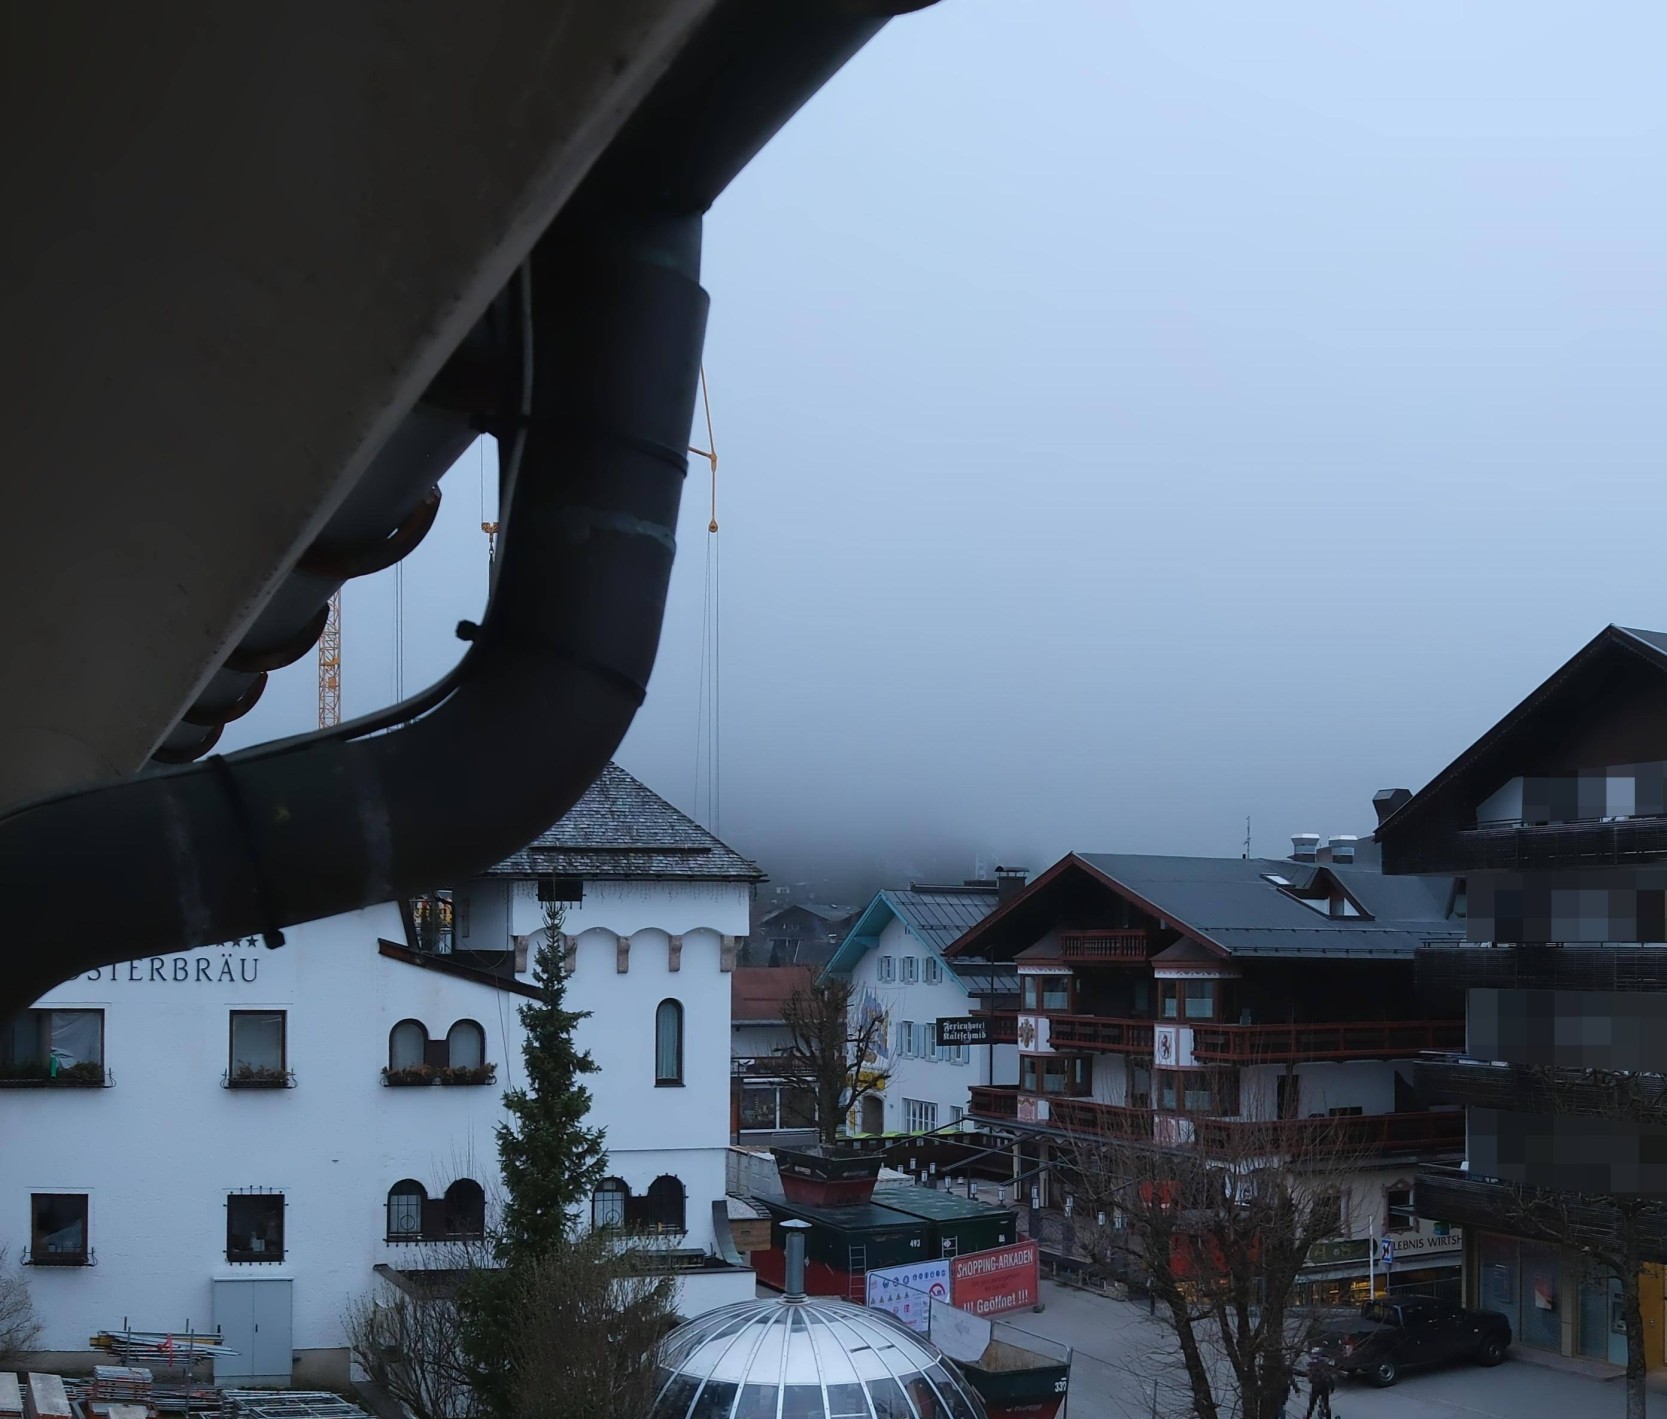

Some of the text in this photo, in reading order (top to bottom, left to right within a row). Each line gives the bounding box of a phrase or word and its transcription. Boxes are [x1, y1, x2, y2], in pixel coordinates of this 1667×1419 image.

[70, 953, 259, 982] STERBRÄU
[957, 1249, 1033, 1278] SHOPPING-ARKADEN
[976, 1292, 1016, 1313] Geöffnet
